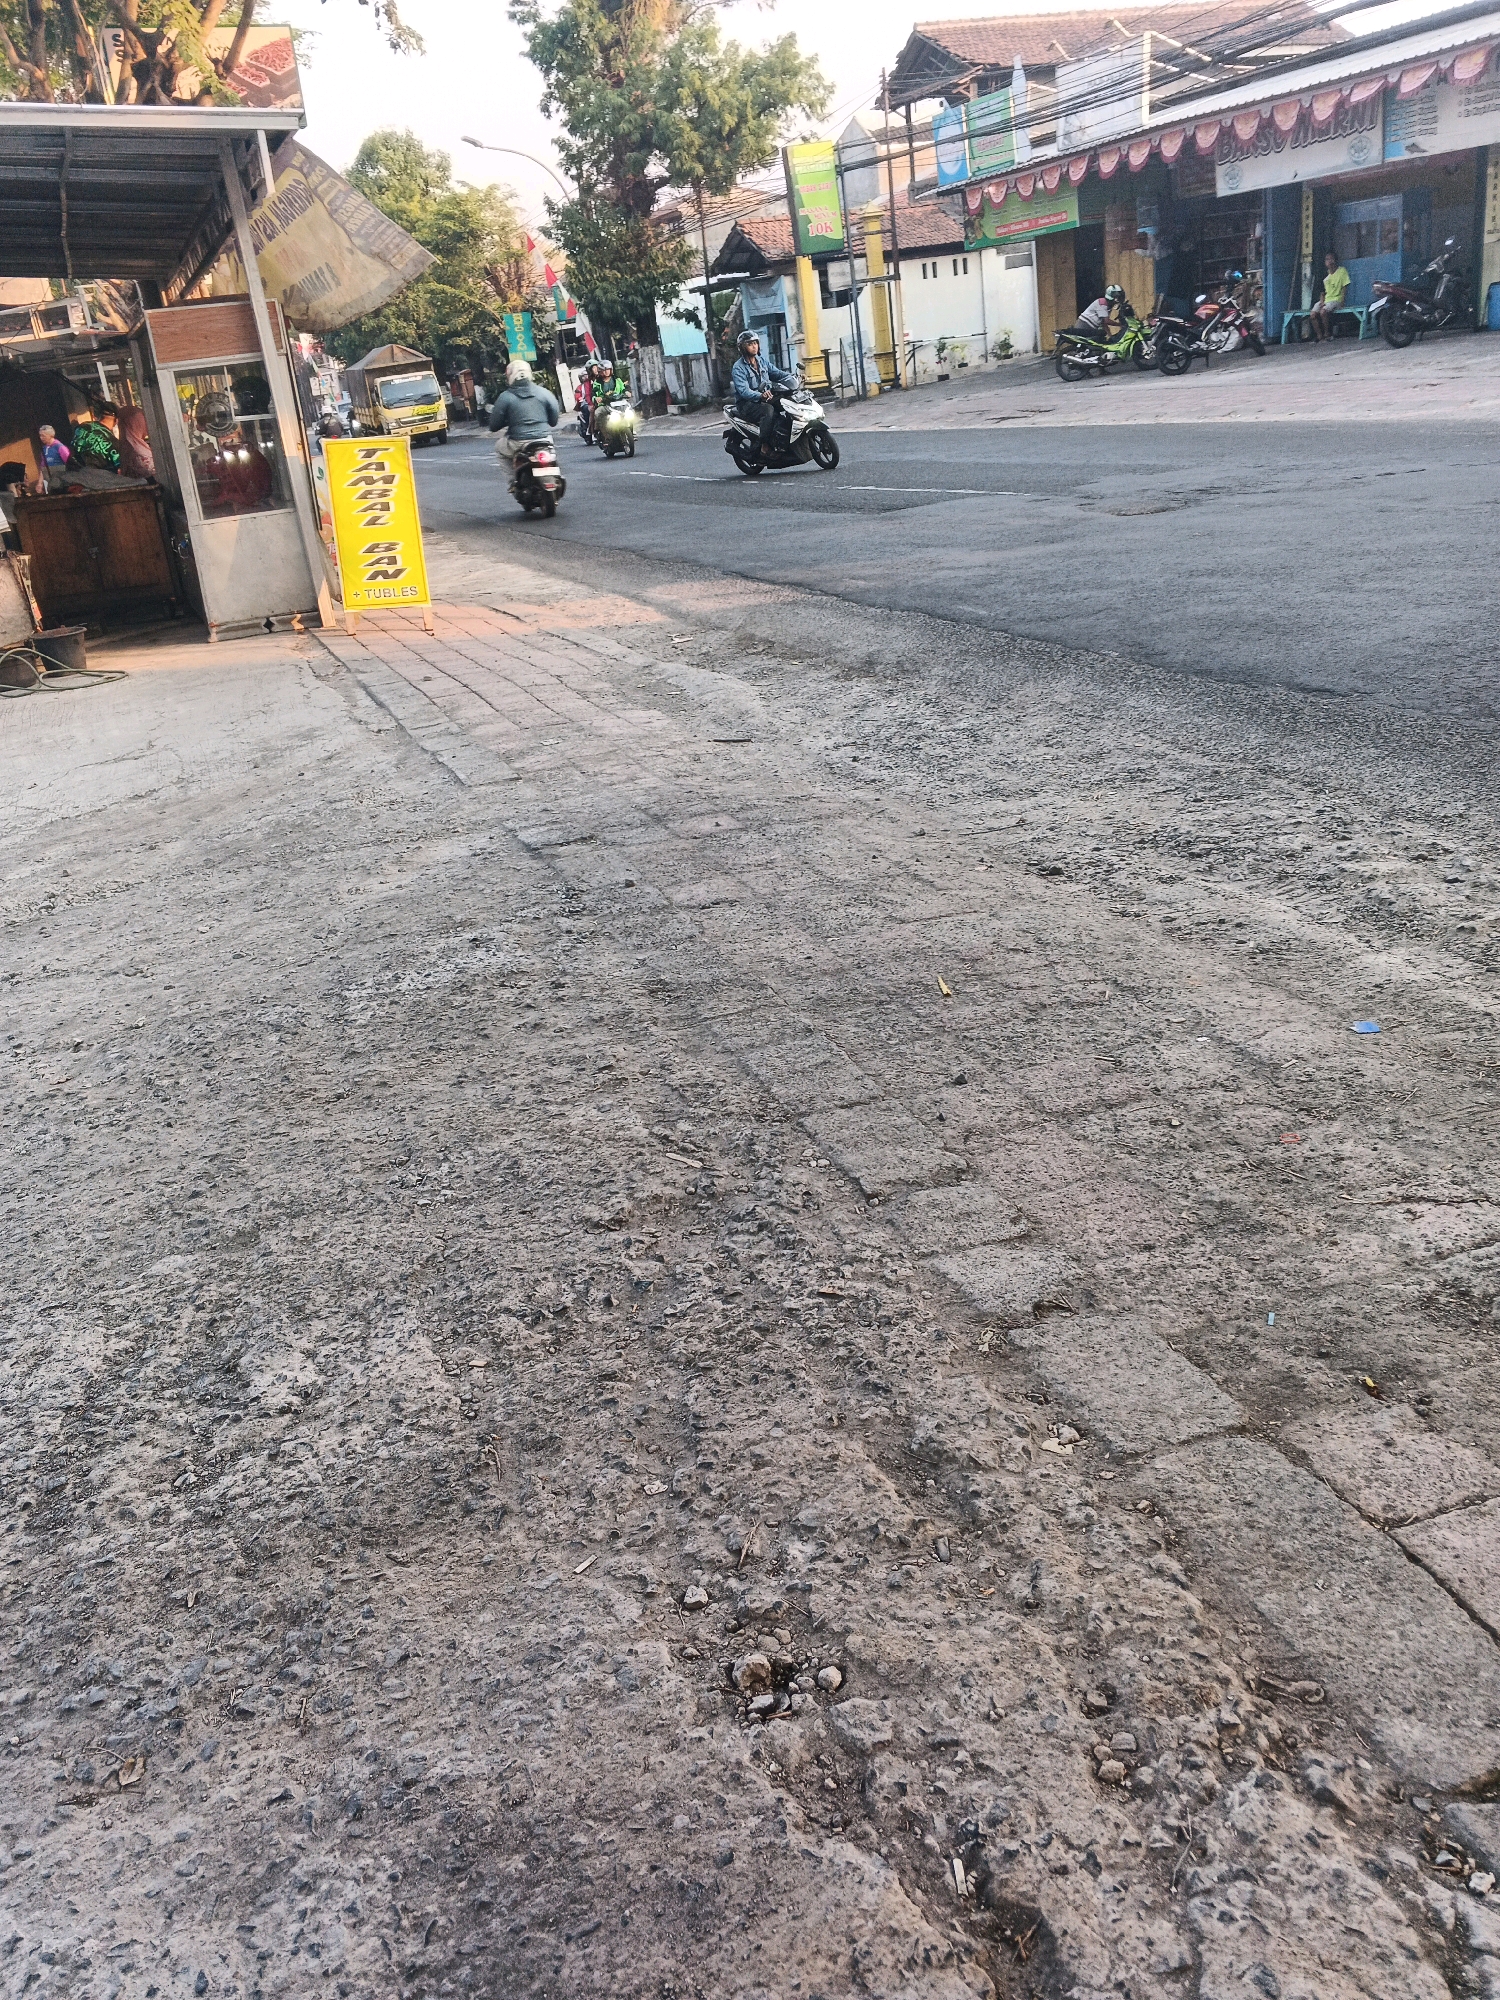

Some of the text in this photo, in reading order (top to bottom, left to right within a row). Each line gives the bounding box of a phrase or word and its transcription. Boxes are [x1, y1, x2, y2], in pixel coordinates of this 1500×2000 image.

[808, 221, 834, 236] 10K
[346, 447, 408, 581] TAMBAL BAN
[364, 586, 418, 599] TUBLES
